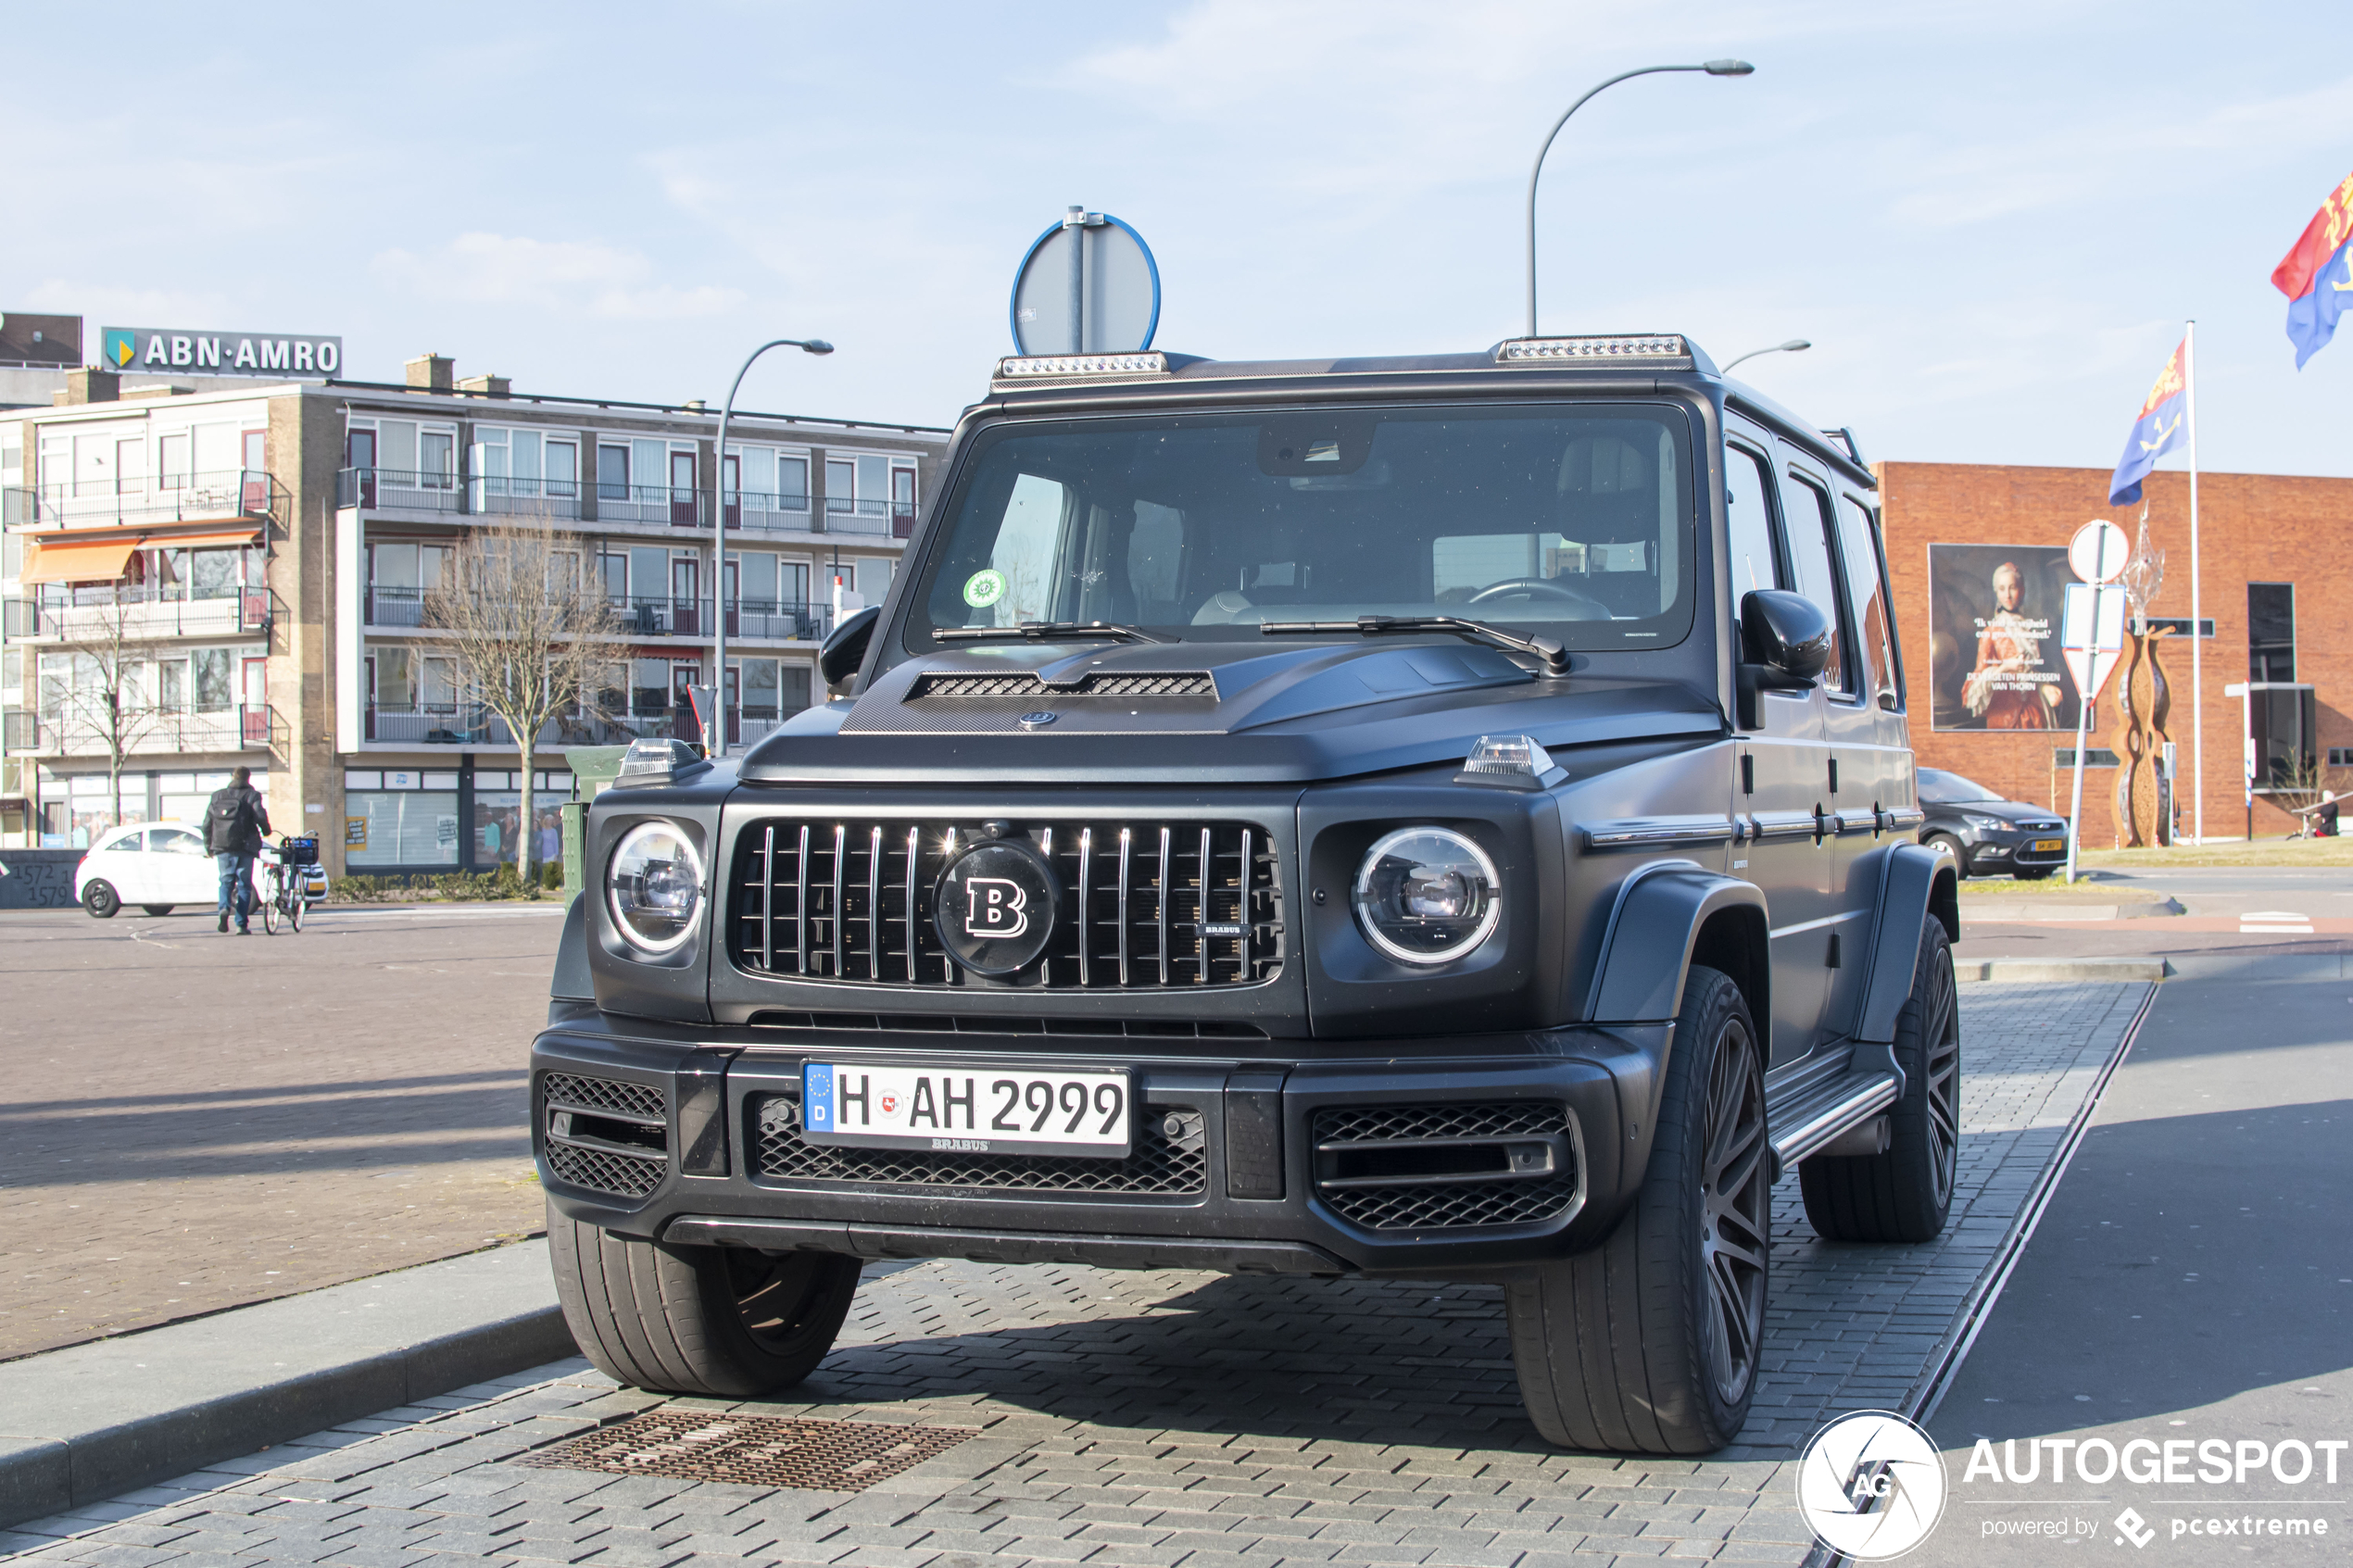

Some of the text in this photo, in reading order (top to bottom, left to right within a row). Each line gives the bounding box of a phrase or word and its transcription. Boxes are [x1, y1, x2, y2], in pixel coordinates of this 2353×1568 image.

[1992, 683, 2007, 691] VAN
[14, 865, 54, 884] 1572
[29, 885, 68, 906] 1579
[966, 877, 1027, 938] B
[814, 1105, 826, 1122] D
[839, 1073, 1124, 1135] H AH 2999
[931, 1137, 990, 1152] BRABUS
